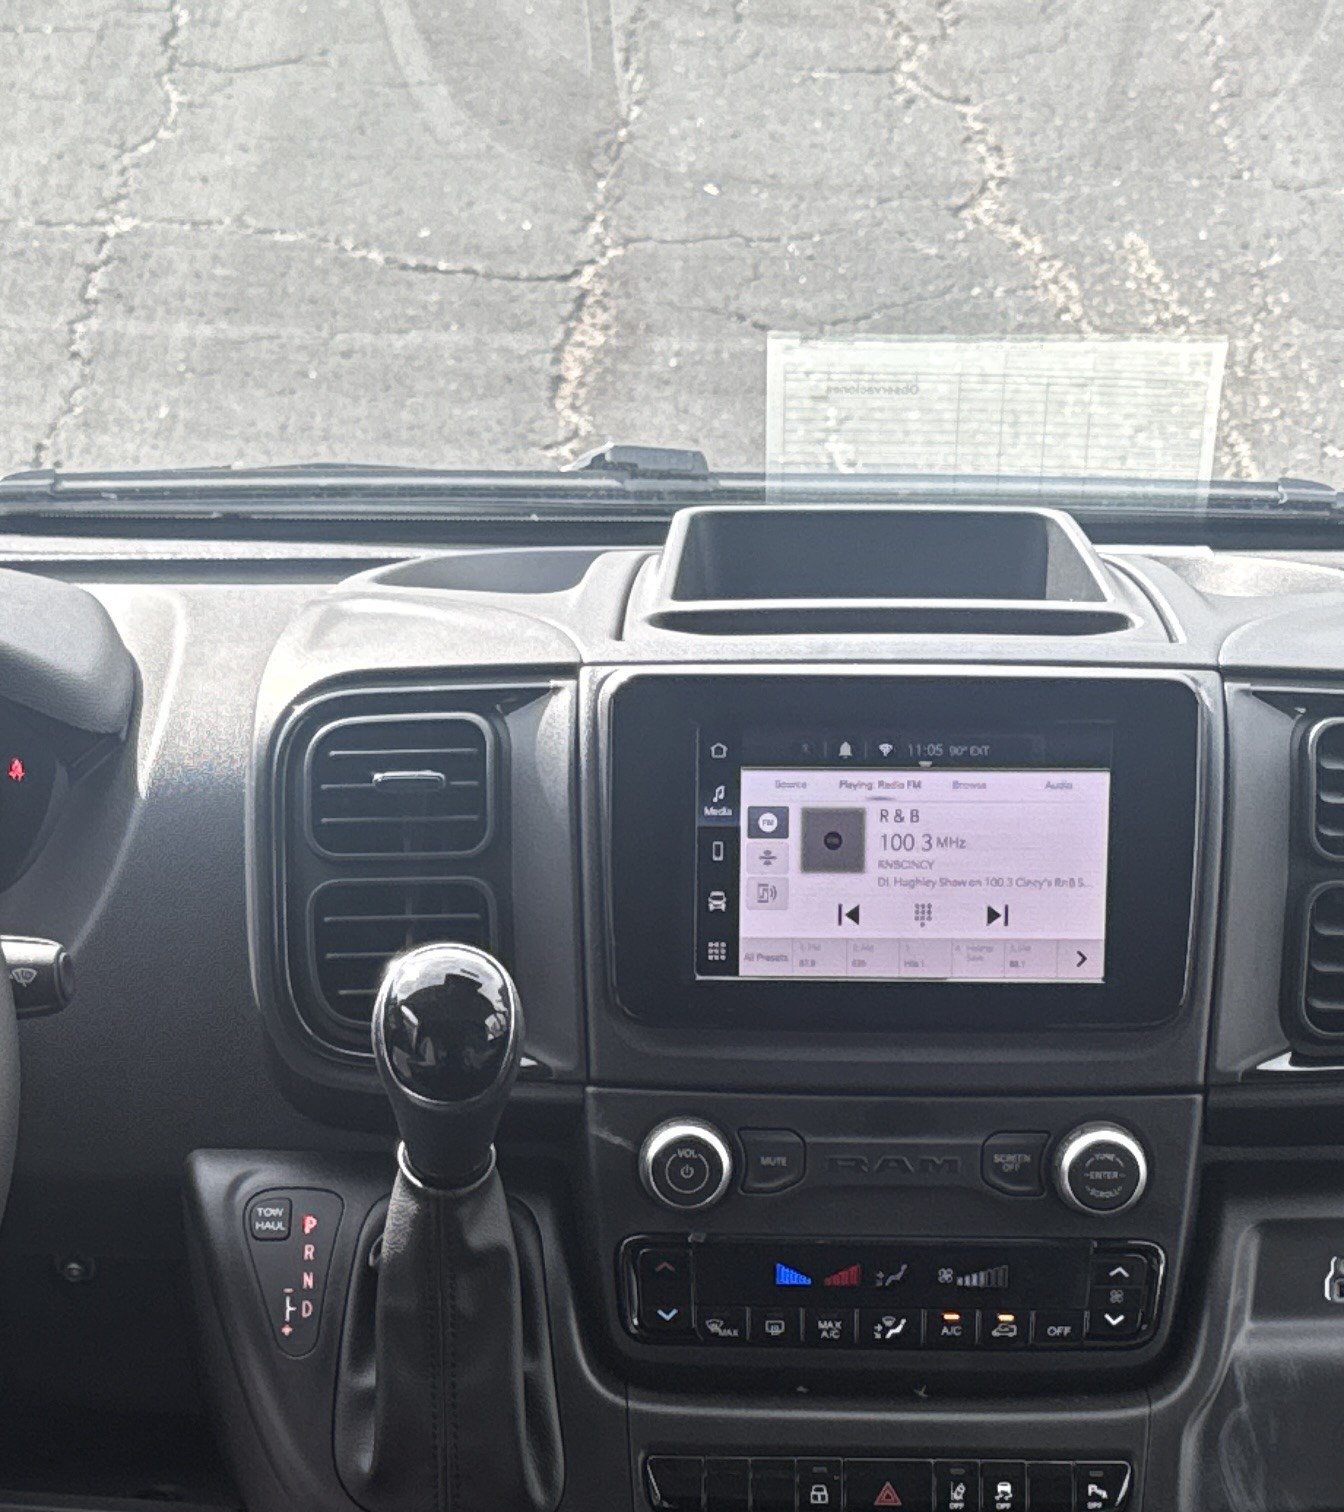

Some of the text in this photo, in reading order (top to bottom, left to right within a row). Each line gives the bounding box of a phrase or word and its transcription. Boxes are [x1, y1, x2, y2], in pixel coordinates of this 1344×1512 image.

[907, 742, 944, 758] 11:05
[879, 808, 920, 824] R & B
[880, 833, 967, 852] 100.3 MHz
[677, 1148, 699, 1160] VOL
[760, 1156, 787, 1167] MUTE
[826, 1155, 962, 1172] RAM
[256, 1207, 285, 1218] TOW
[256, 1220, 286, 1232] HAUL
[302, 1214, 318, 1235] P
[303, 1244, 316, 1261] R
[303, 1271, 314, 1290] N
[301, 1300, 313, 1319] D
[817, 1320, 843, 1330] MAX
[940, 1325, 963, 1337] A/C
[1046, 1325, 1072, 1338] OFF
[719, 1328, 739, 1338] MAX
[820, 1330, 841, 1340] A/C
